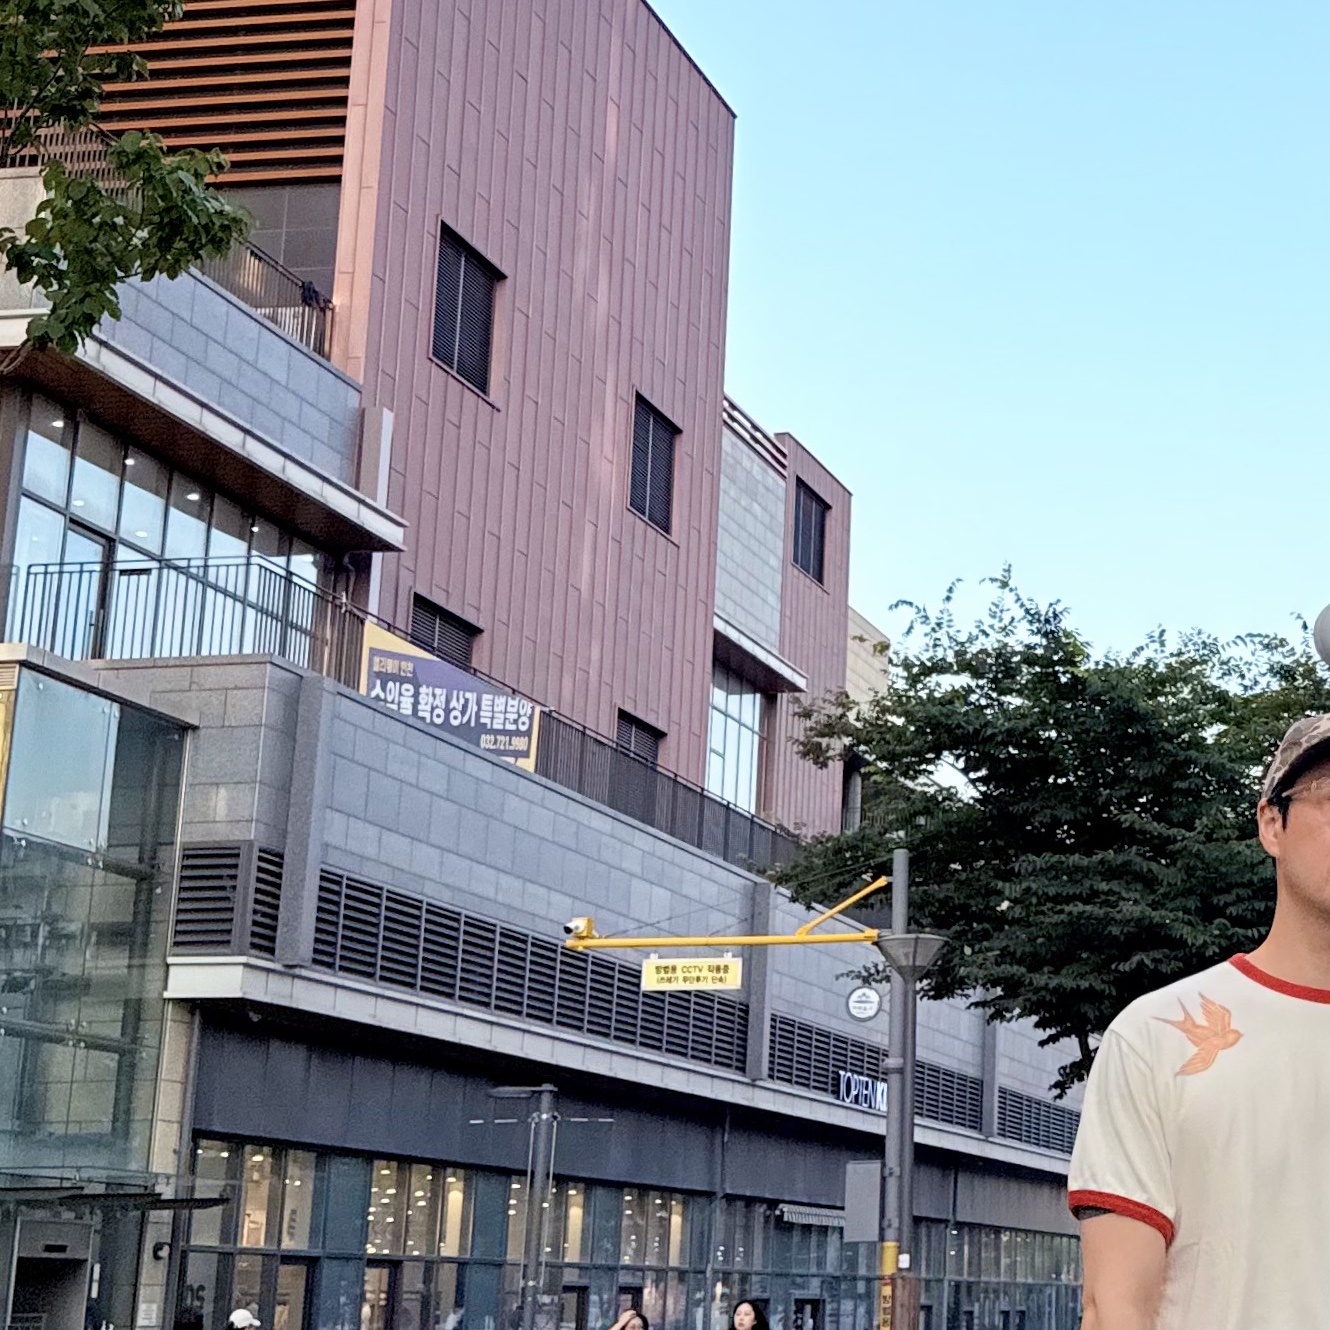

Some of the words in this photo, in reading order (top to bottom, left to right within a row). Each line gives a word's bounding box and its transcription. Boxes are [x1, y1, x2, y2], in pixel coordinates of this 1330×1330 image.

[418, 684, 448, 723] 확정
[449, 690, 478, 727] 상가
[480, 693, 533, 732] 특별분양
[681, 965, 704, 974] CCTV
[838, 1070, 877, 1109] TOPTEN
